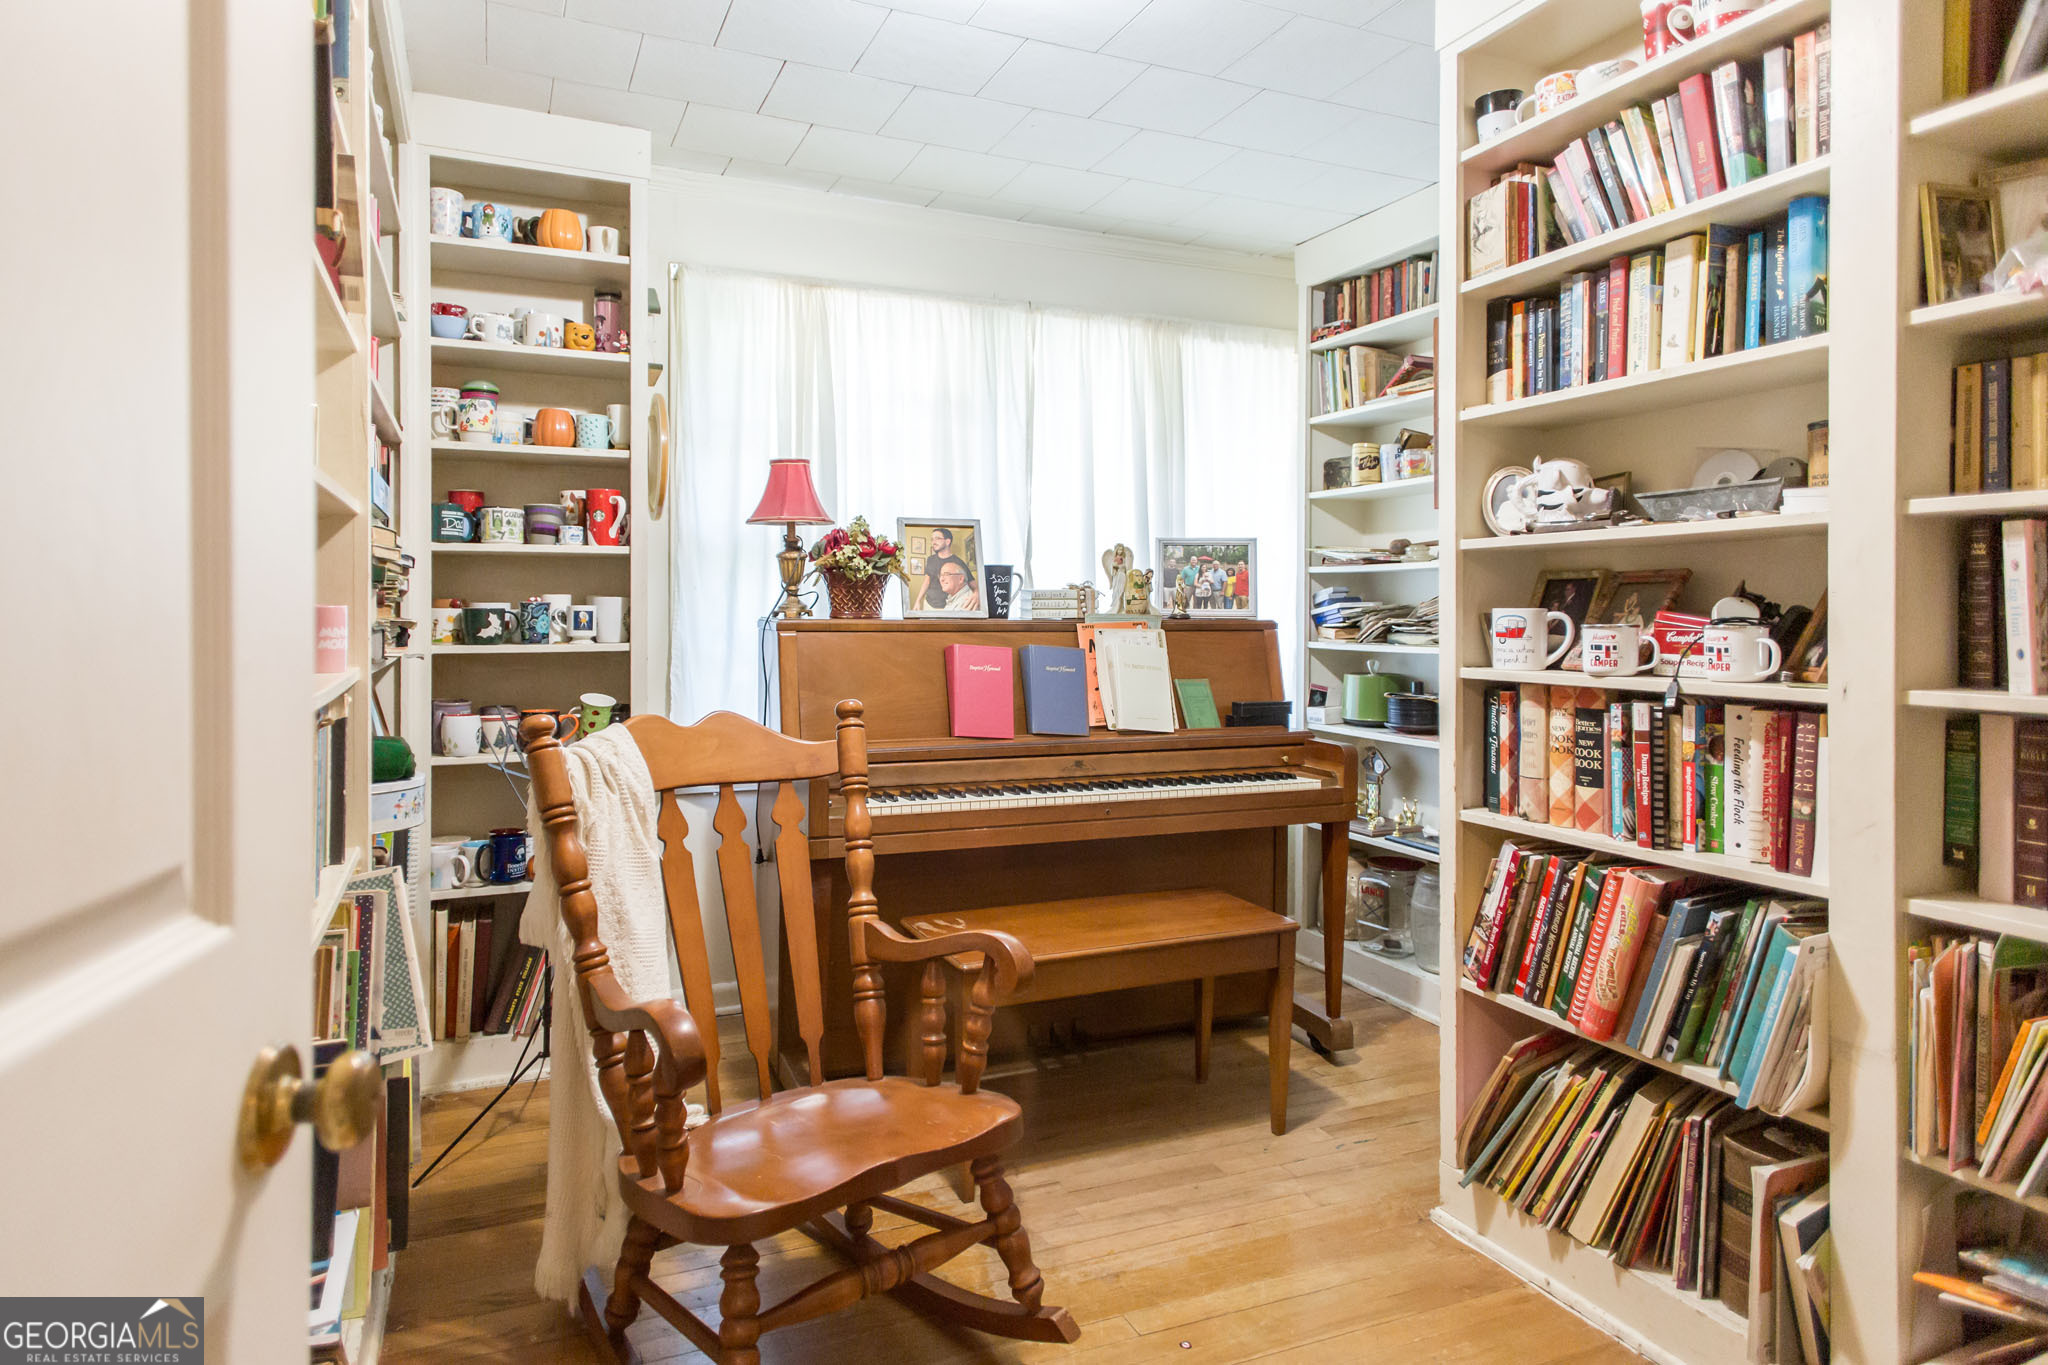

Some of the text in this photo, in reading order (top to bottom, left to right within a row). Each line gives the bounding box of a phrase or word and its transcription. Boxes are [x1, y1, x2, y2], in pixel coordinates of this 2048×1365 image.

[1751, 238, 1759, 273] NICHOLAS
[1775, 245, 1784, 285] Nightingale
[442, 517, 463, 529] Da
[1666, 631, 1704, 645] Campbell
[1590, 659, 1618, 668] CAMPER
[1686, 659, 1705, 668] Recip
[1489, 696, 1498, 775] Timeless Treasures
[1575, 718, 1597, 727] Better
[1551, 735, 1574, 743] OOK
[1578, 739, 1596, 747] NEW
[1575, 748, 1602, 759] COOK
[1794, 723, 1804, 791] AUTUMN
[1803, 723, 1816, 792] SHILOH
[2021, 751, 2047, 761] BIBLE
[1640, 753, 1649, 805] Dump Recipes
[1731, 737, 1745, 825] Feeding the Flock
[1760, 722, 1773, 823] Cooking With MICKEY
[1710, 776, 1718, 828] Slow Cooker
[1794, 823, 1806, 855] THOENE
[1530, 918, 1540, 941] ANNUAL
[1535, 895, 1547, 919] RECIPES
[1541, 932, 1557, 962] MACHINE
[1568, 926, 1579, 950] ANNUAL
[1573, 931, 1584, 955] ANNUAL
[1527, 956, 1537, 982] RECIPES
[1562, 949, 1573, 973] RECIPES
[1567, 955, 1578, 980] RECIPES
[1534, 962, 1549, 988] BAKING
[504, 956, 532, 1023] VALDOSTA STATE COLLEGE
